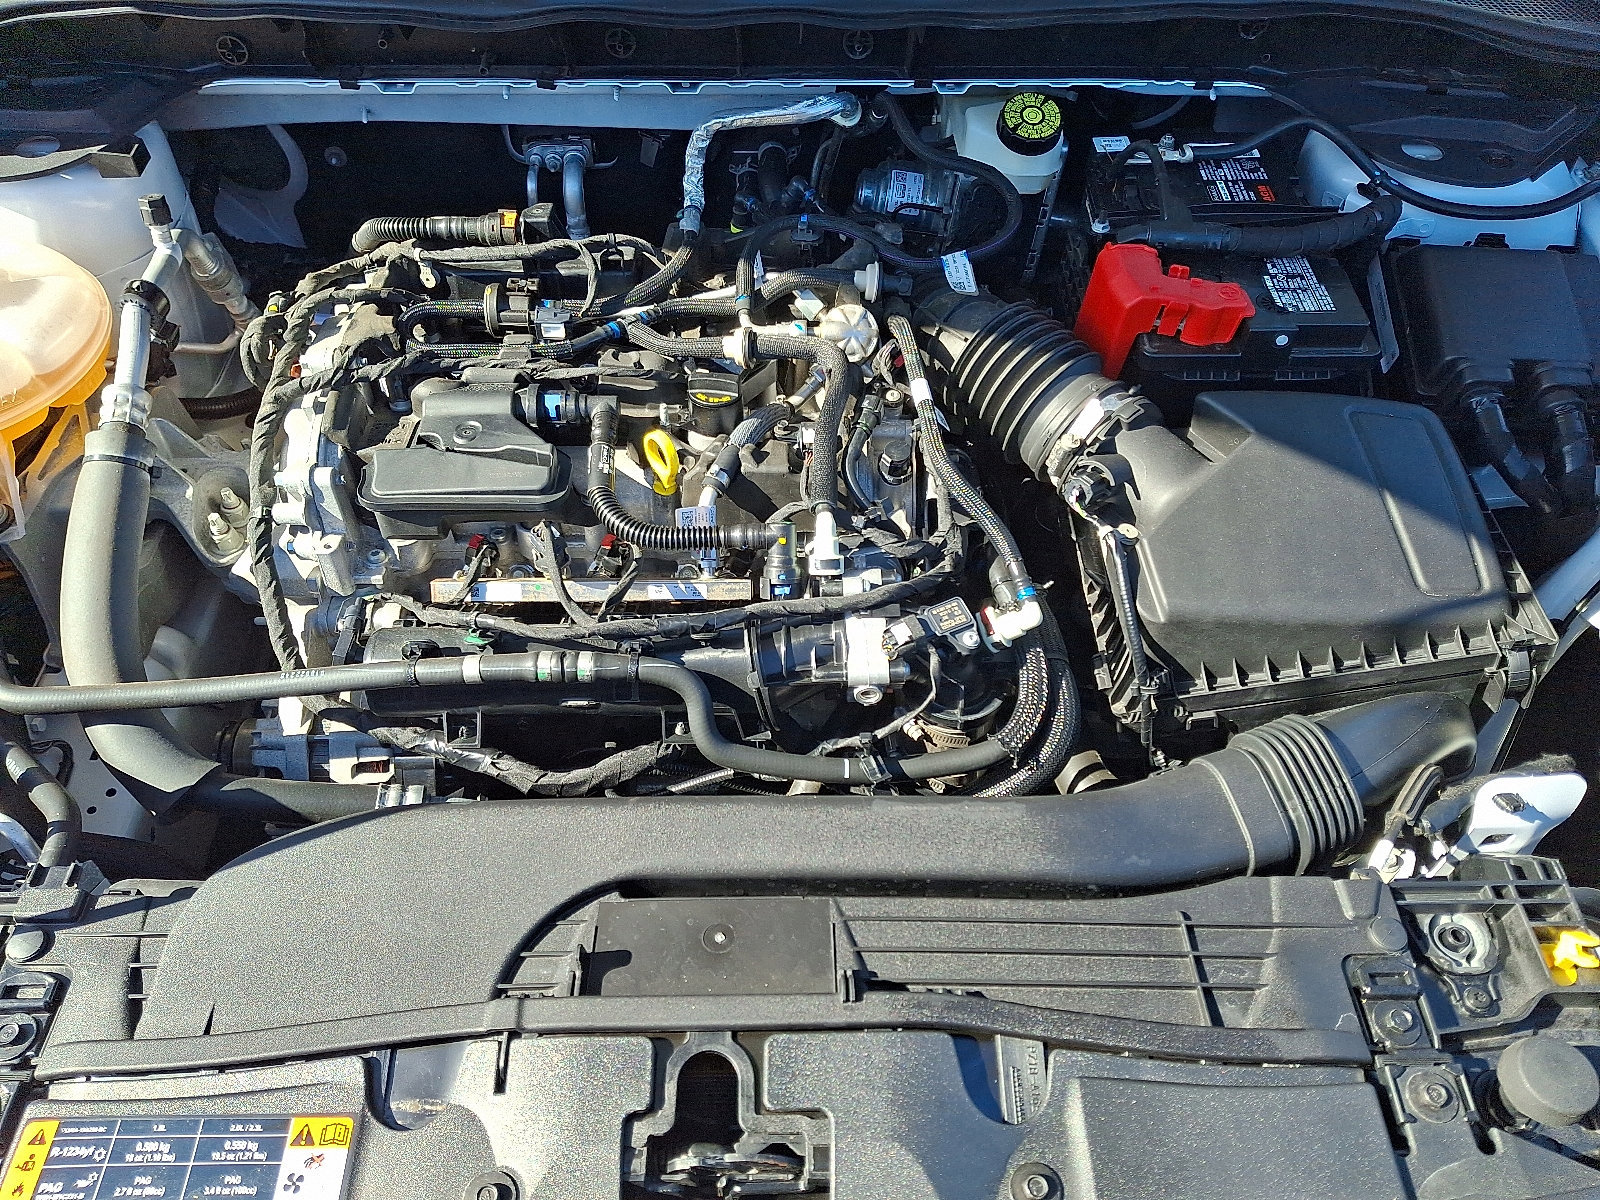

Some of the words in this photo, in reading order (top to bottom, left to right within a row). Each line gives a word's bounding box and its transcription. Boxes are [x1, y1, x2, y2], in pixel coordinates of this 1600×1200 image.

[1257, 185, 1272, 201] AGM
[49, 1145, 96, 1159] R-1234yf
[159, 1141, 171, 1153] kg
[247, 1140, 259, 1152] kg
[134, 1176, 152, 1185] PAG
[224, 1175, 242, 1185] PAG
[37, 1181, 64, 1194] PAG
